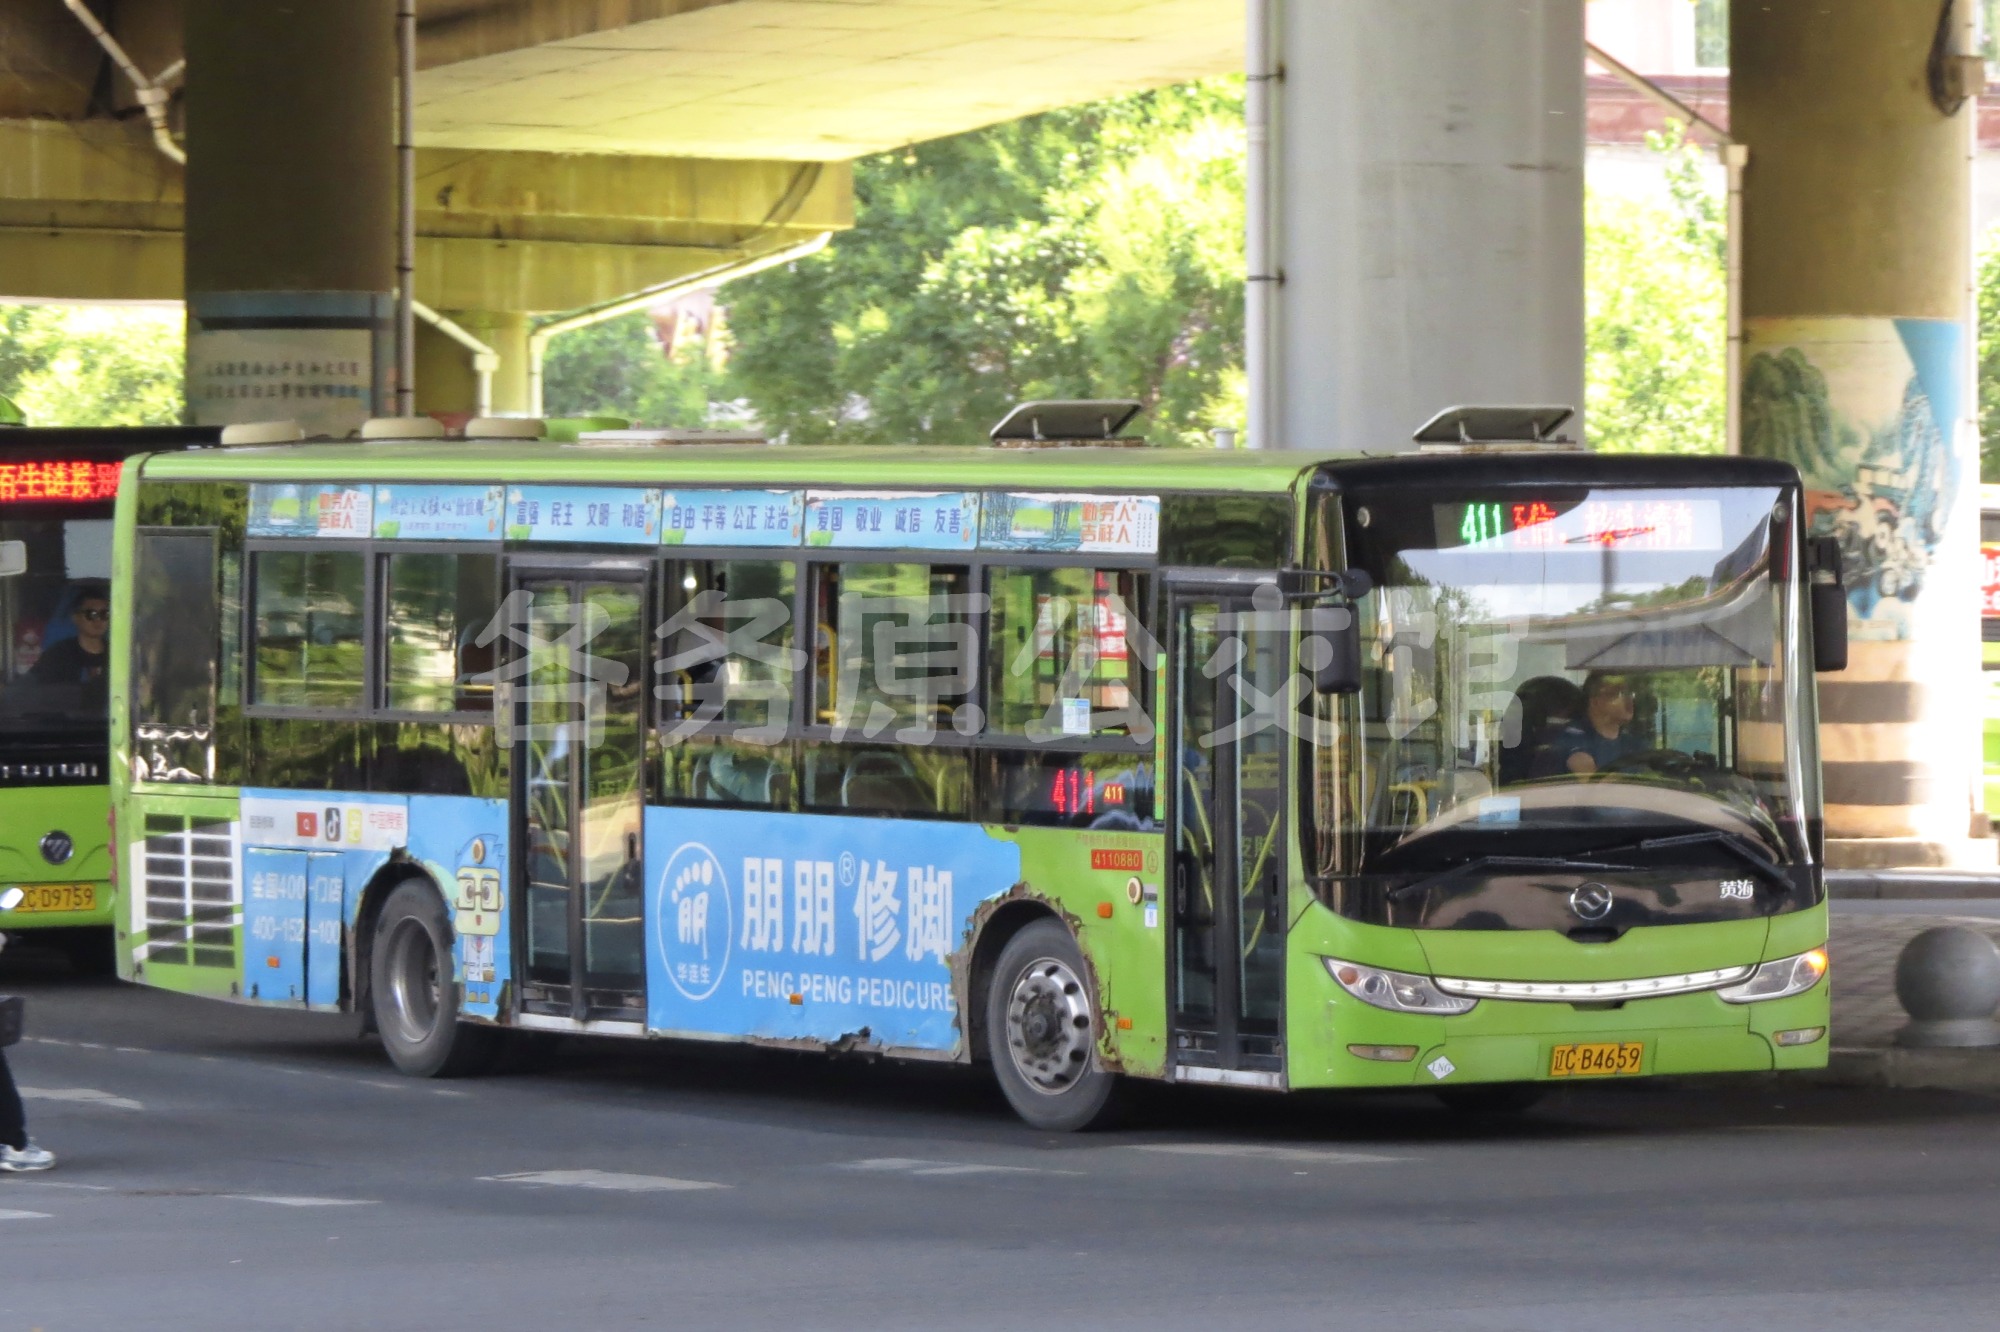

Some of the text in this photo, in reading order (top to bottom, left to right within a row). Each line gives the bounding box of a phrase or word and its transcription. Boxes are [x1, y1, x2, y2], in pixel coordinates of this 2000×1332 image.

[516, 500, 646, 528] 富强 民主 文明 和谐
[671, 505, 789, 531] 自由 平等 公正 法治
[817, 506, 962, 535] 爱国 敬业 诚信 友善
[1460, 503, 1503, 548] 411
[1081, 523, 1131, 544] 吉祥人
[1052, 769, 1095, 815] 411
[1104, 786, 1124, 800] 411
[1094, 850, 1140, 868] 4110880
[16, 887, 94, 908] CD9759
[1719, 879, 1754, 899] 黄海
[742, 968, 956, 1013] PENG PENG PEDICURE
[1431, 1061, 1452, 1073] LNG
